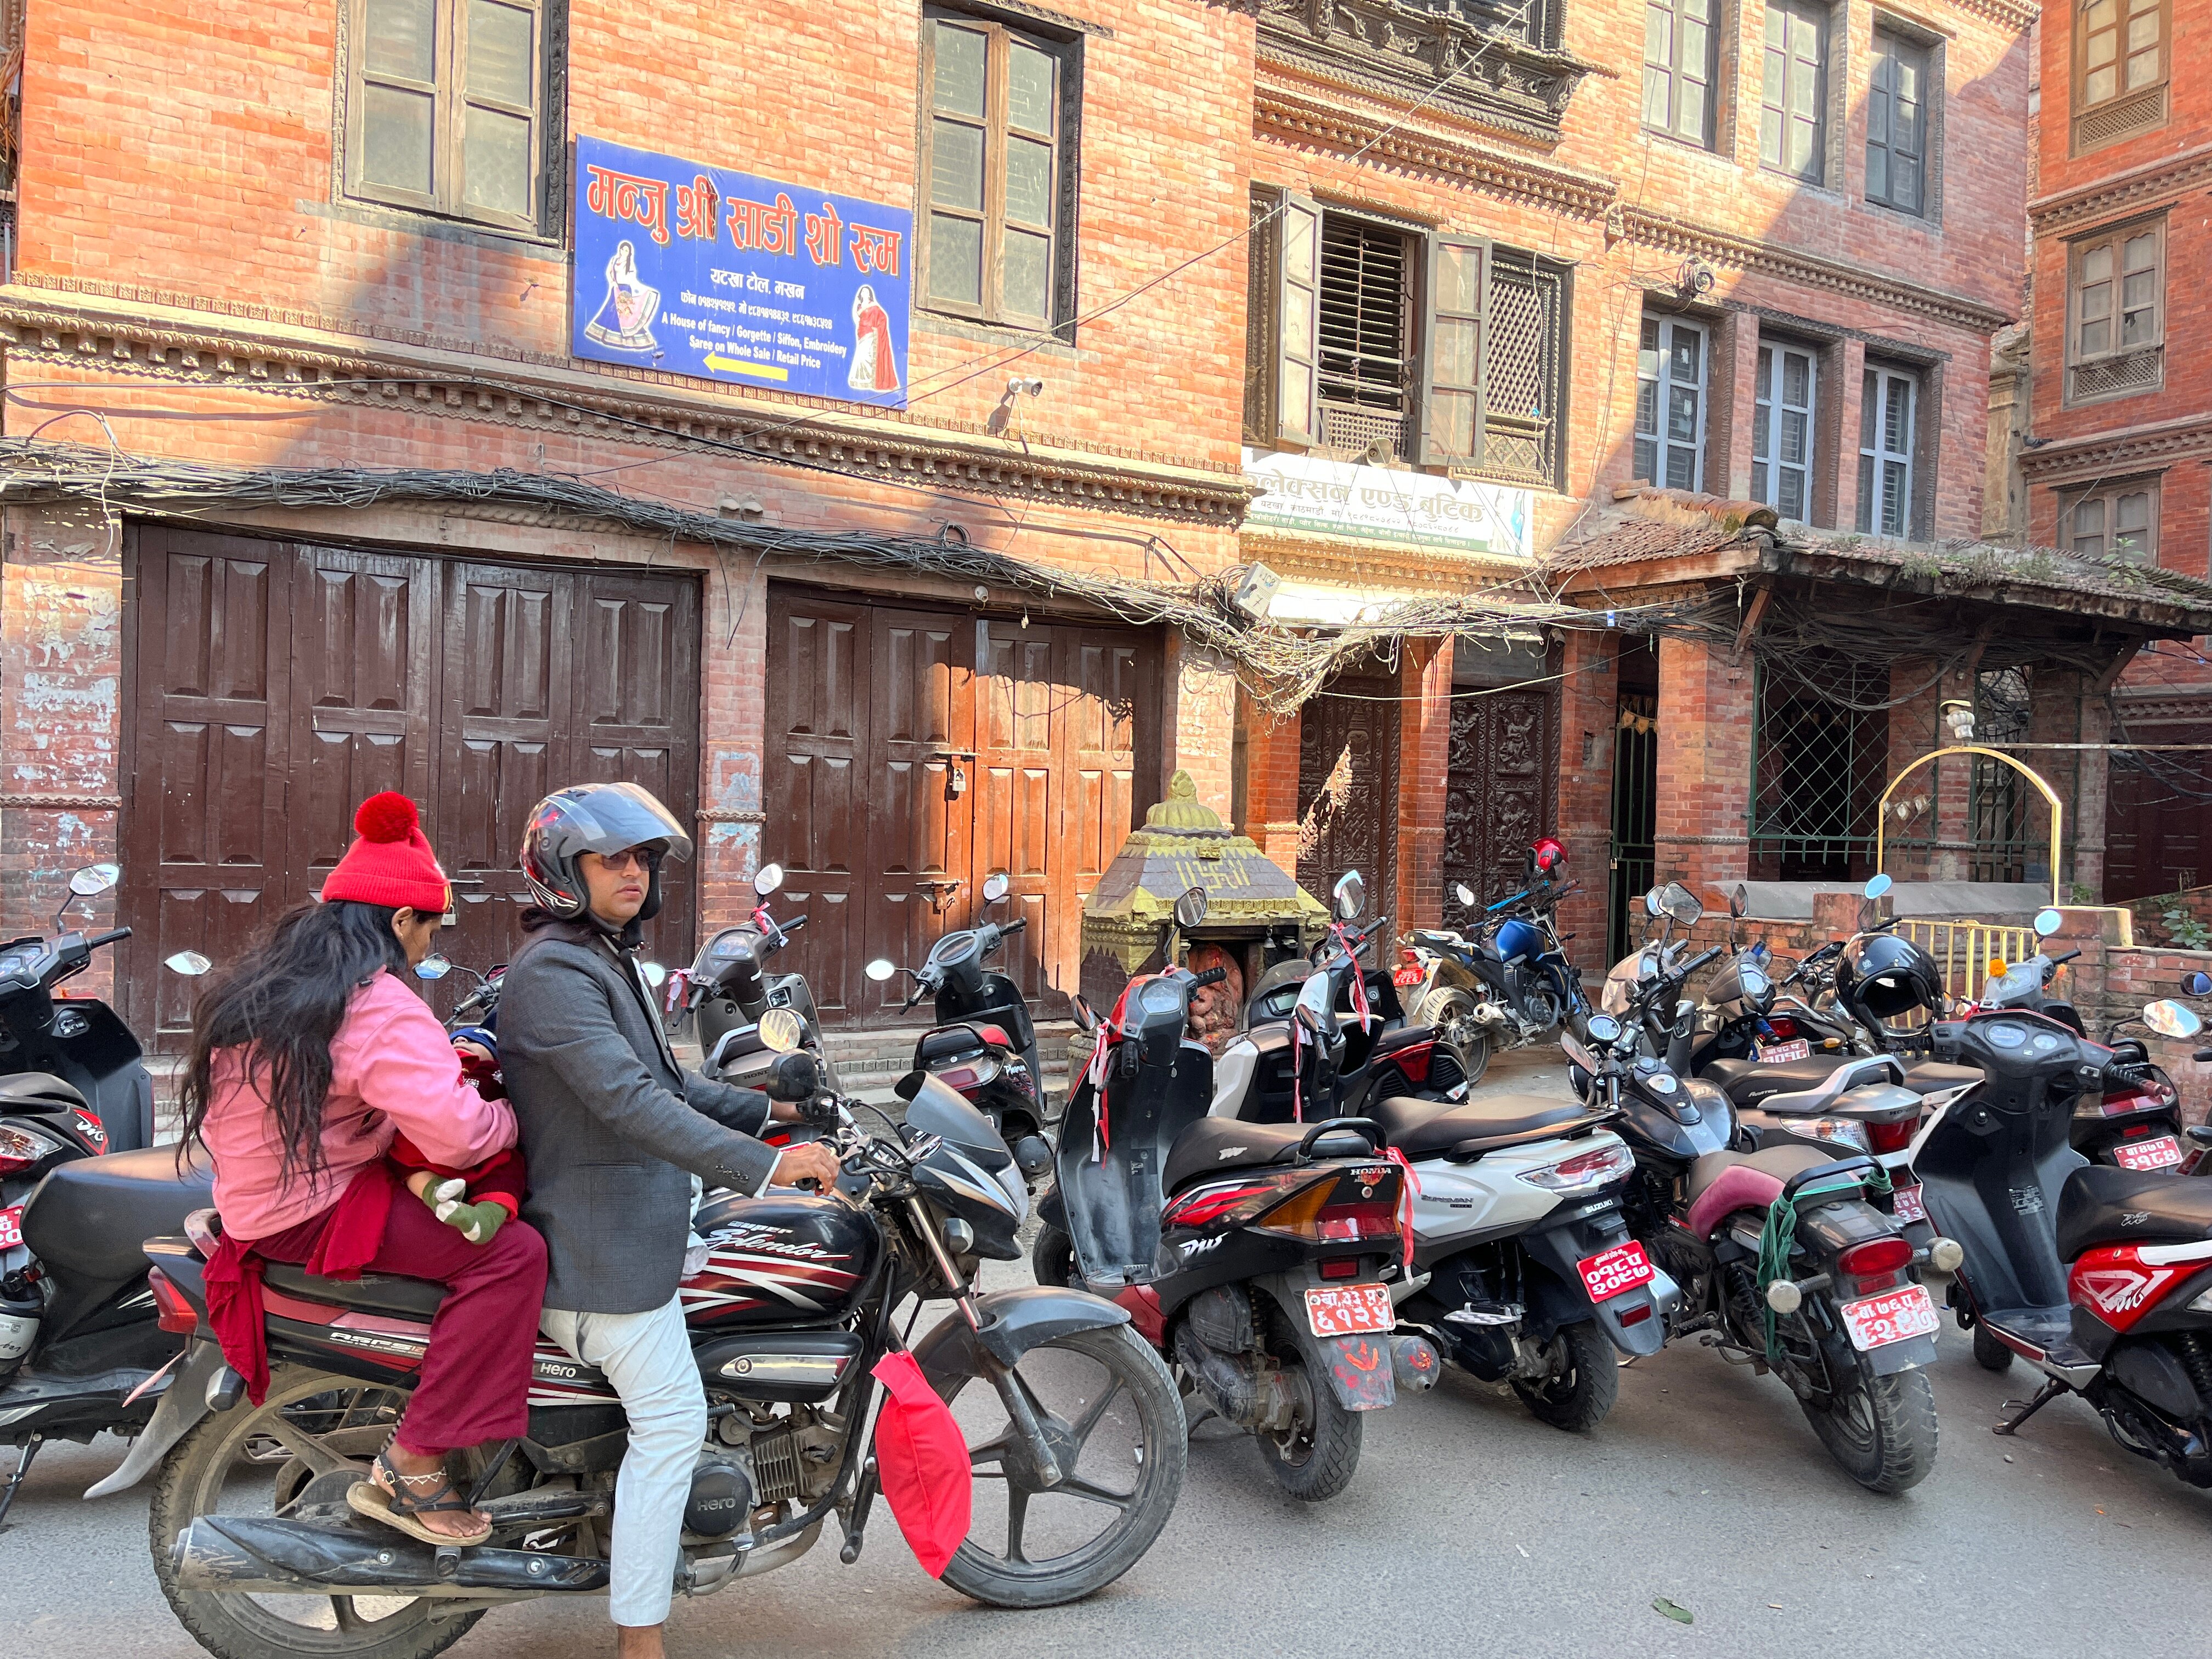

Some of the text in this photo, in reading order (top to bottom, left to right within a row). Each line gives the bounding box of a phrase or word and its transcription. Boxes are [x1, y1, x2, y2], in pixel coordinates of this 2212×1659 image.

[587, 165, 902, 276] मन्जु श्री साडी शो रूम
[681, 289, 697, 305] फोन
[710, 268, 744, 288] यटखा
[775, 280, 805, 300] मखन
[662, 312, 669, 324] A
[670, 312, 696, 329] House
[698, 319, 707, 331] of
[708, 320, 731, 338] fancy
[731, 324, 735, 336] /
[736, 325, 771, 343] Gorgette
[777, 331, 802, 350] Siffon,
[804, 337, 847, 358] Embroidery
[690, 335, 713, 351] Saree
[715, 341, 725, 352] on
[727, 341, 752, 357] Whole
[753, 346, 770, 360] Sale
[776, 350, 799, 365] Retail
[800, 355, 821, 369] Price
[1360, 488, 1413, 511] एण्ड
[1419, 493, 1485, 520] बुटिक
[743, 1070, 768, 1080] HON
[2124, 1149, 2177, 1170] ३१८४
[1585, 1199, 1613, 1214] SUZUKI
[703, 1228, 852, 1261] Splendor
[1592, 1265, 1650, 1295] २०९७
[1317, 1306, 1390, 1331] ६१२५
[540, 1363, 576, 1378] Hero
[697, 1497, 736, 1511] Hero
